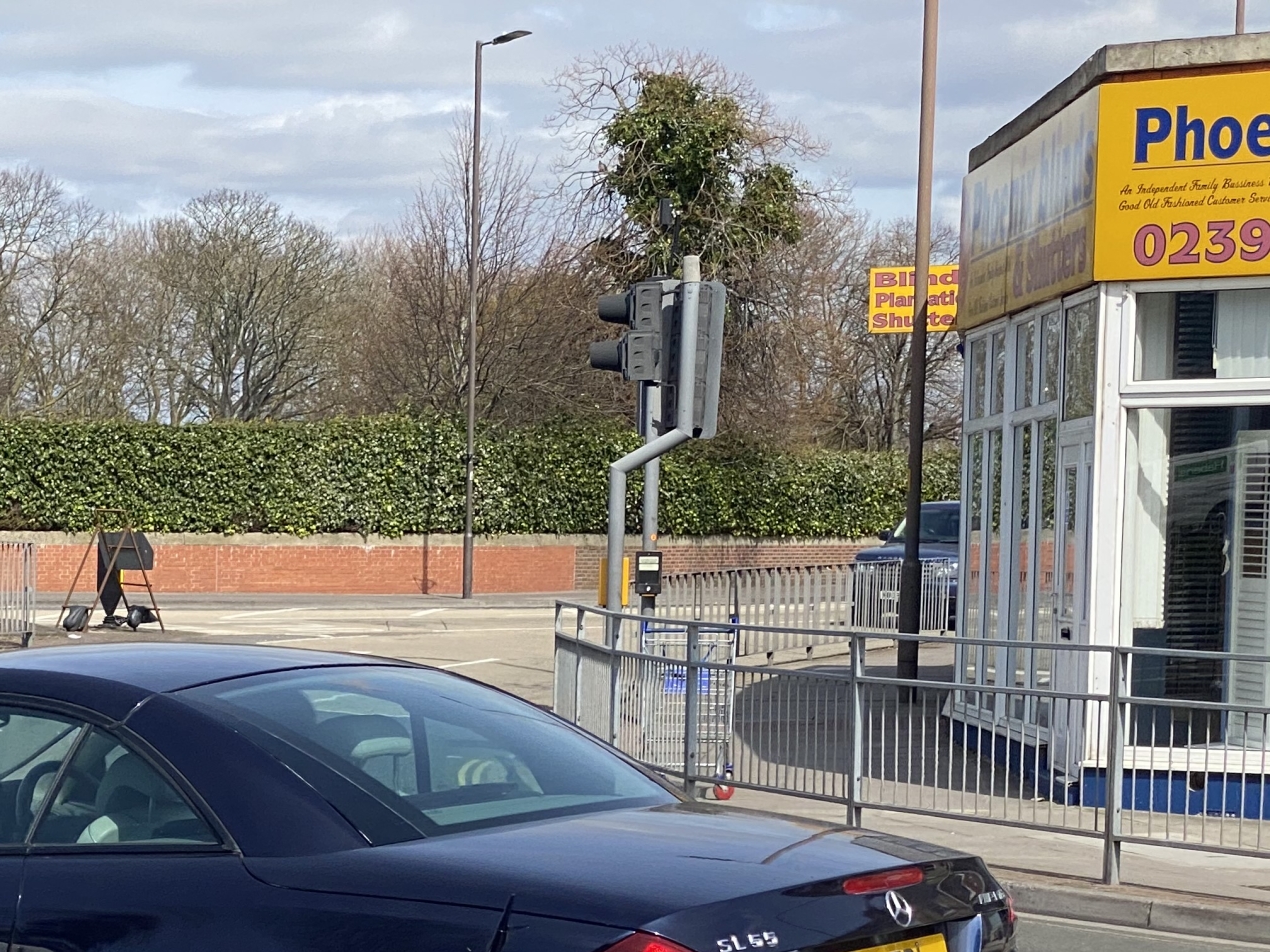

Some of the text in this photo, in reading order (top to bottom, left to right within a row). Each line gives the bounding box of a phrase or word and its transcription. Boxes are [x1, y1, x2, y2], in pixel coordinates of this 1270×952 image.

[1134, 105, 1270, 163] Phoe
[1119, 200, 1140, 211] Good
[1143, 198, 1159, 209] Old
[1161, 196, 1205, 208] Fashioned
[1207, 194, 1245, 206] Customer
[1120, 184, 1132, 195] An
[1136, 182, 1187, 197] Independent
[1189, 178, 1218, 194] Family
[1133, 218, 1270, 267] 0239
